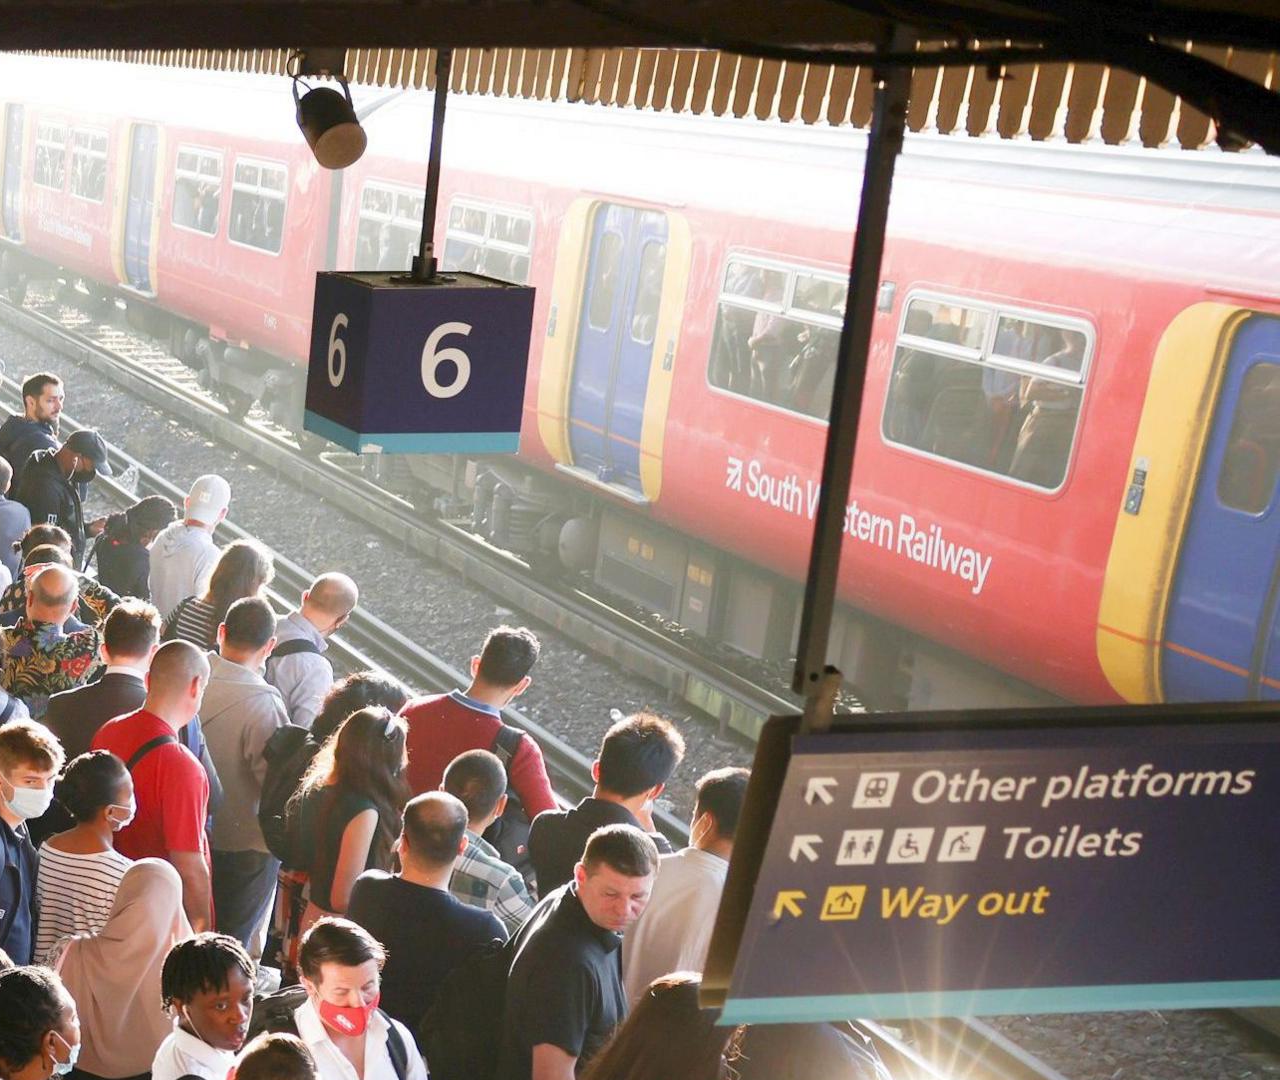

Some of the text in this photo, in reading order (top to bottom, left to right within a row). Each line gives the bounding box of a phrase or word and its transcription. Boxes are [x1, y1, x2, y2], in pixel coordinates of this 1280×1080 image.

[327, 312, 349, 388] 6
[421, 321, 472, 399] 6
[745, 459, 803, 515] South
[896, 513, 992, 595] Railway
[910, 763, 1256, 808] Other platforms
[1002, 824, 1143, 860] Toilets
[879, 885, 1050, 925] Way out
